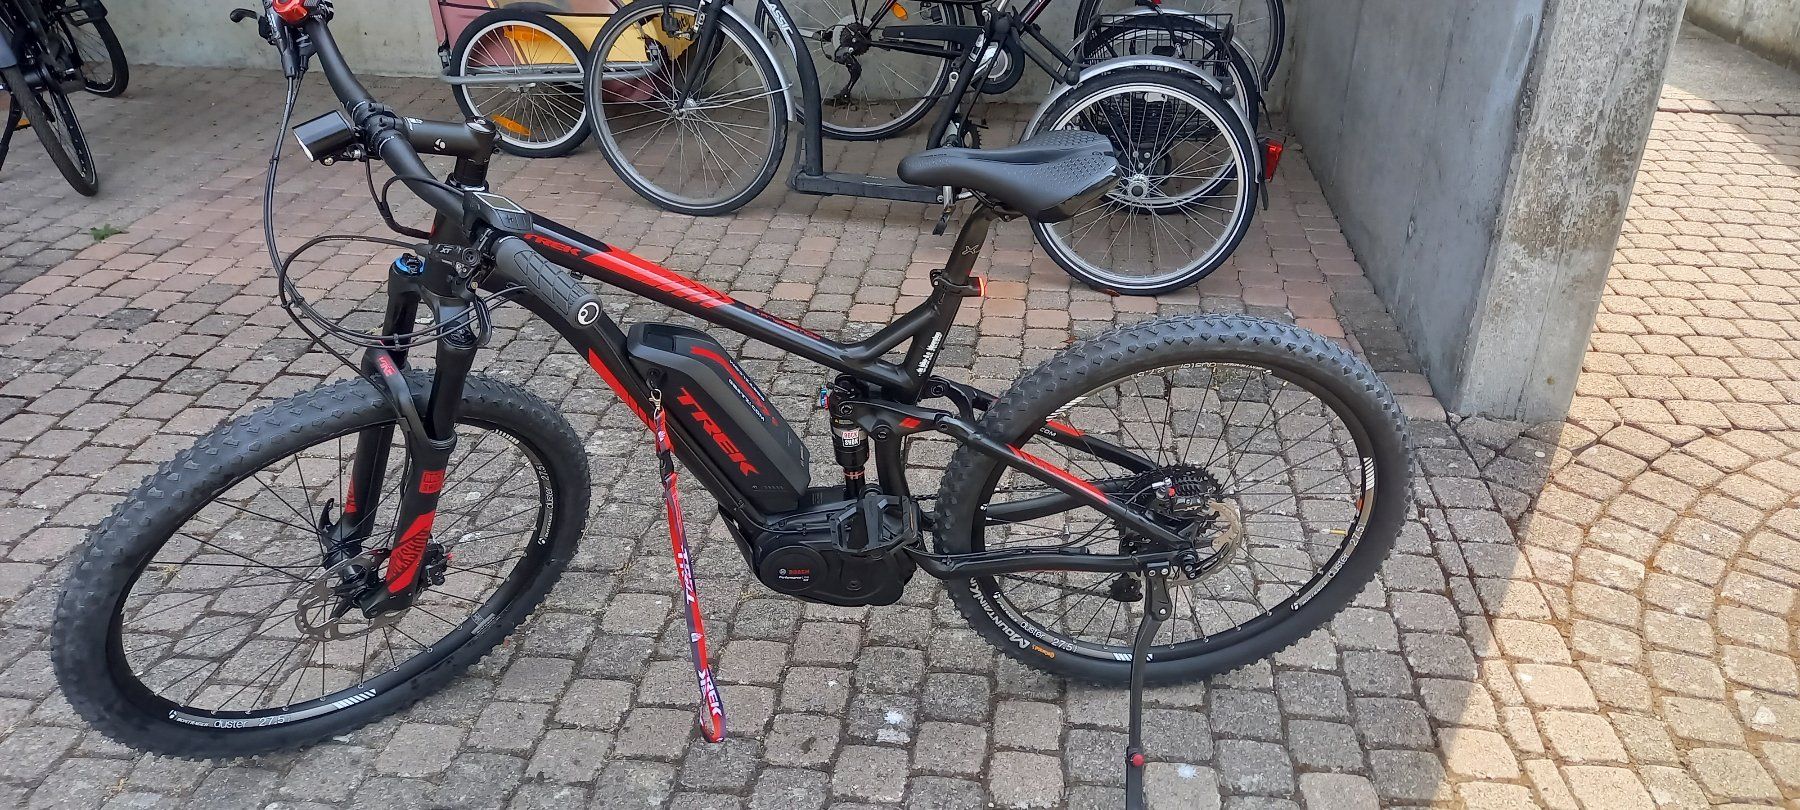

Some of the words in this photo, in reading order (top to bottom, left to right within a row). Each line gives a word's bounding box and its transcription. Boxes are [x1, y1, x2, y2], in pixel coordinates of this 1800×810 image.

[523, 233, 582, 257] TREK
[677, 386, 761, 478] TREK
[969, 576, 1031, 649] MOUNTAINKIN
